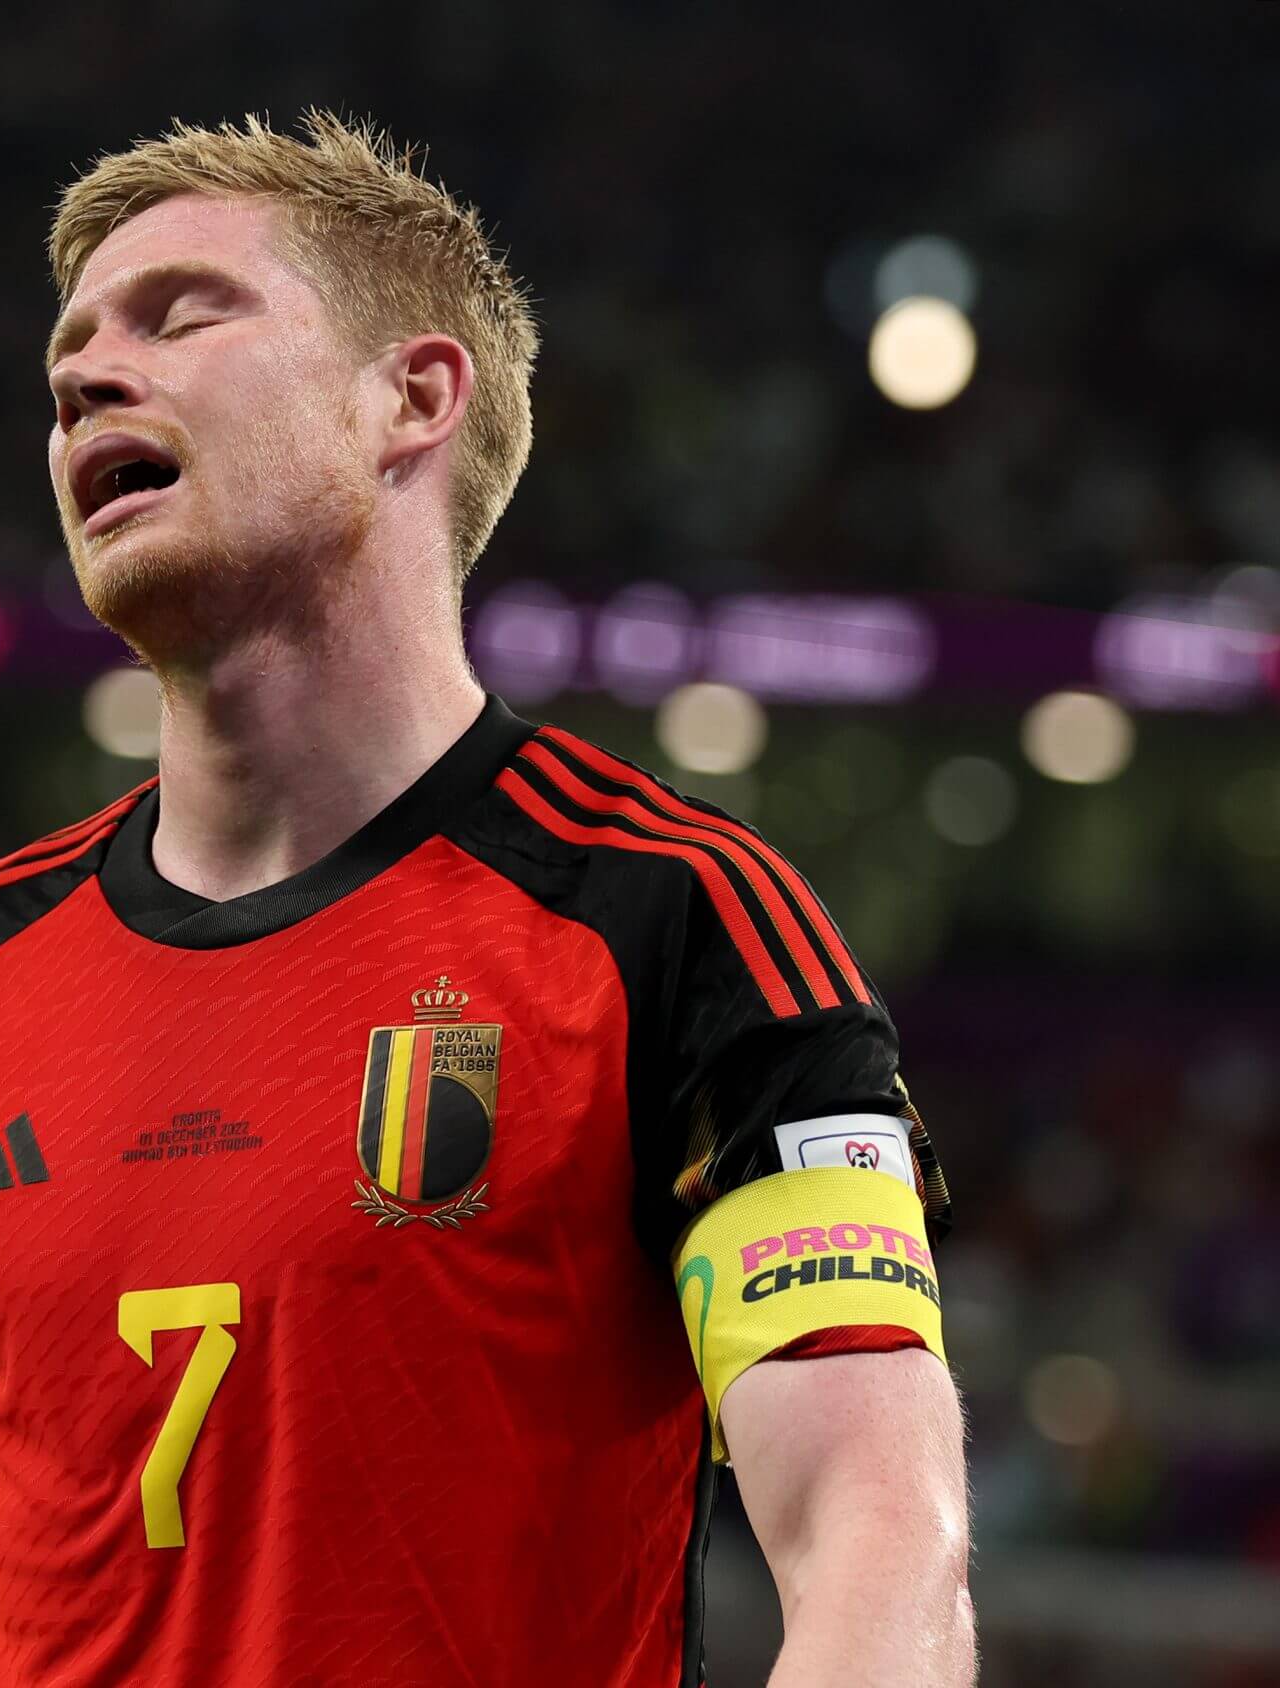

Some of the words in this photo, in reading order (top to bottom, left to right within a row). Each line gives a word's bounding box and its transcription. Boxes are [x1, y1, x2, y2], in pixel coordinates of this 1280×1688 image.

[436, 1030, 481, 1043] ROYAL
[434, 1044, 496, 1057] BELGIAN
[157, 1125, 216, 1144] DECEMBER
[221, 1121, 249, 1136] 2022
[118, 1282, 241, 1549] 7
